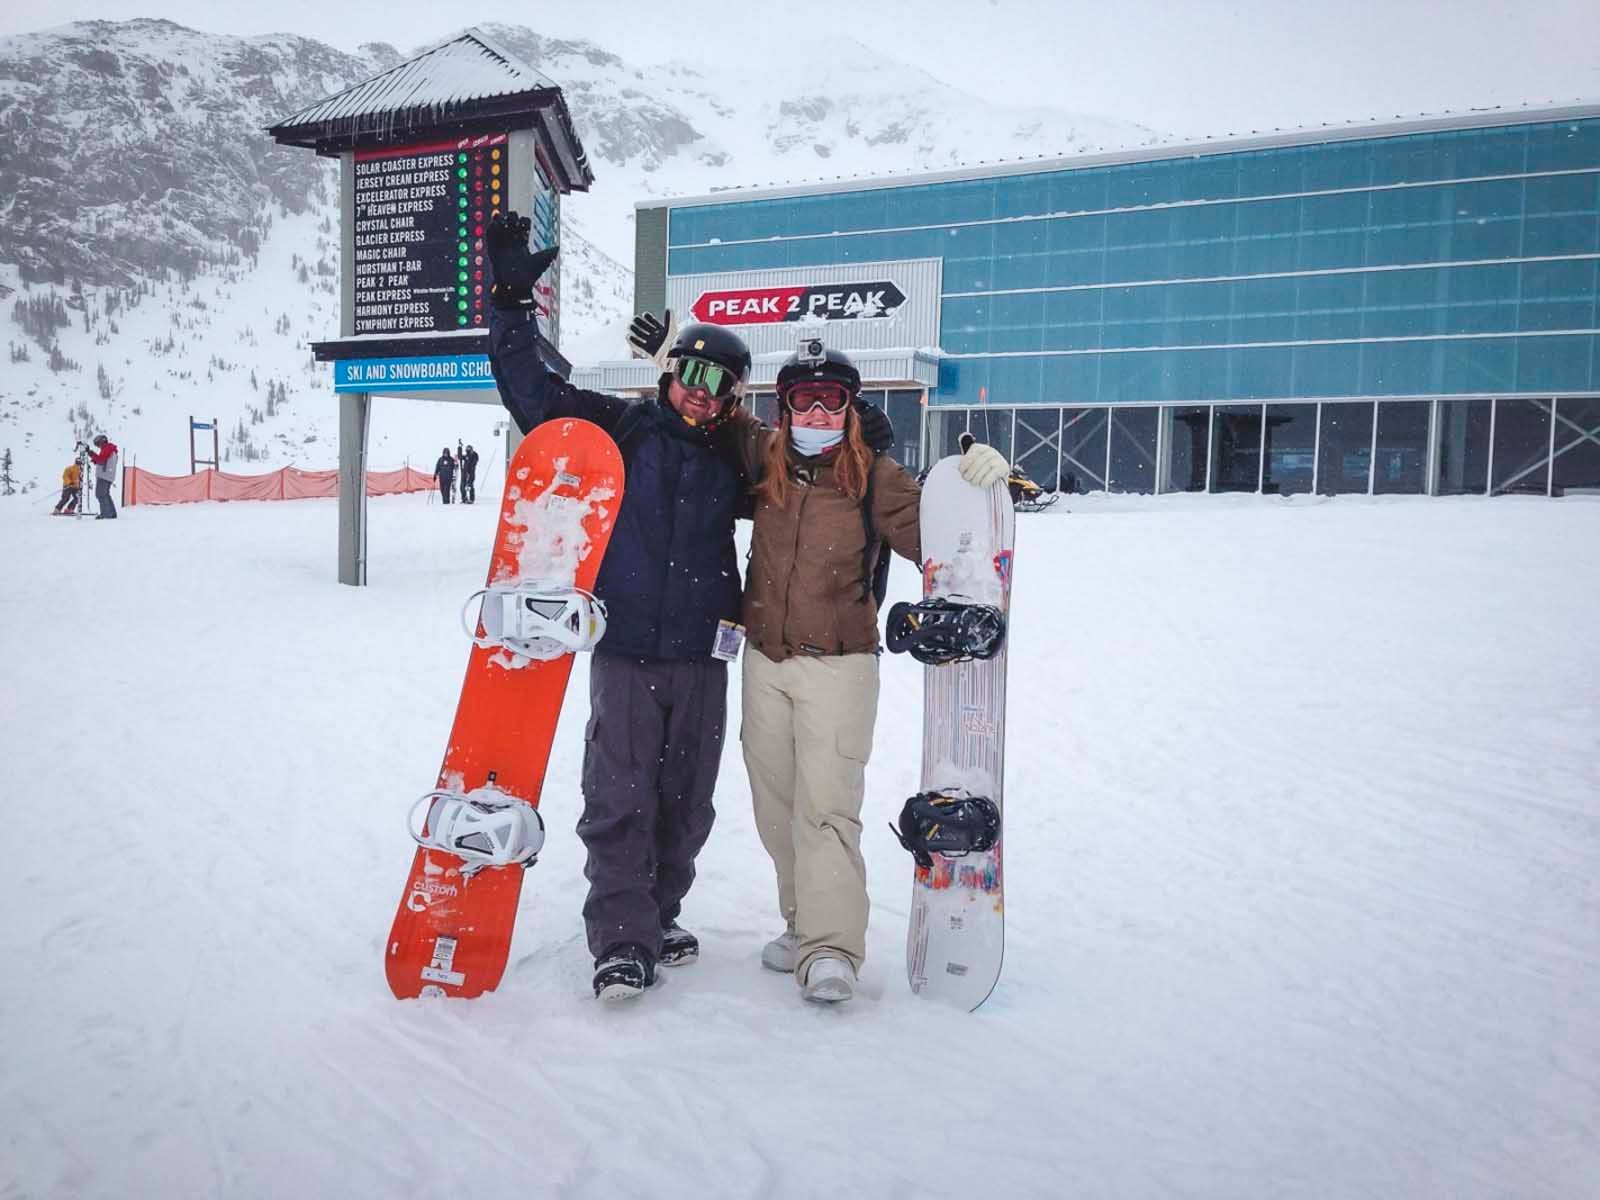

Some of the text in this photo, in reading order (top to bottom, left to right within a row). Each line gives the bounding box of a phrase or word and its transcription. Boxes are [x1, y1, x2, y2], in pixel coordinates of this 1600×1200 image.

[356, 154, 454, 175] SOLAR COASTER EXPRESS
[356, 170, 450, 190] JERSEY CREAM EXPRESS
[356, 185, 446, 204] EXCELERATOR EXPRESS
[367, 203, 396, 216] HEAVEN
[398, 200, 433, 213] EXPRESS
[356, 217, 414, 232] CRYSTAL CHAIR
[356, 230, 425, 246] GLACIER EXPRESS
[356, 247, 407, 261] MAGIC CHAIR
[356, 260, 422, 275] HORSTMAN T-BAR
[356, 274, 409, 288] PEAK 2 PEAK
[356, 291, 376, 303] PEAK
[377, 289, 412, 301] EXPRESS
[356, 302, 430, 316] HARMONY EXPRESS
[708, 290, 886, 318] PEAK 2 PEAK
[356, 316, 435, 331] SYMPHONY EXPRESS
[347, 365, 363, 381] SKI
[366, 364, 386, 380] AND
[389, 362, 458, 379] SNOWBOARD
